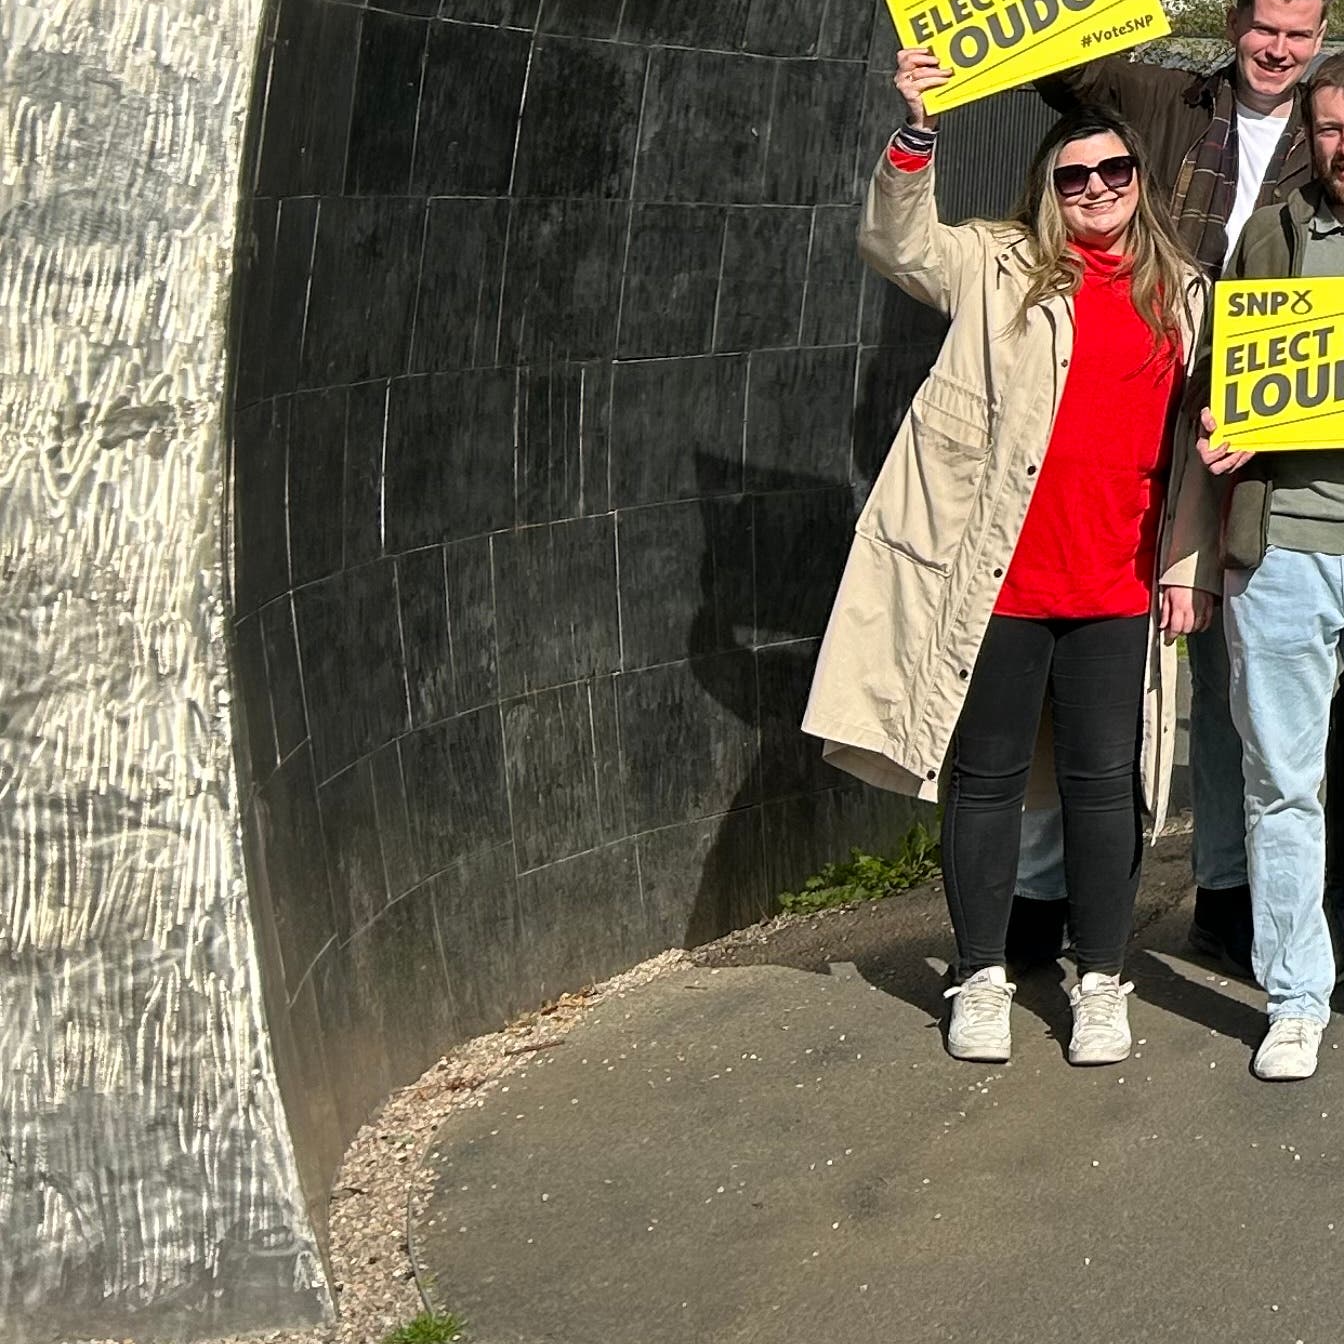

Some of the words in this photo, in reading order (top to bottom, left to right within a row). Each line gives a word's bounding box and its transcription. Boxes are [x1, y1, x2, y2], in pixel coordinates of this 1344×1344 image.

[1081, 14, 1153, 48] #VoteSNP
[1228, 291, 1289, 317] SNP
[1226, 326, 1335, 377] ELECT
